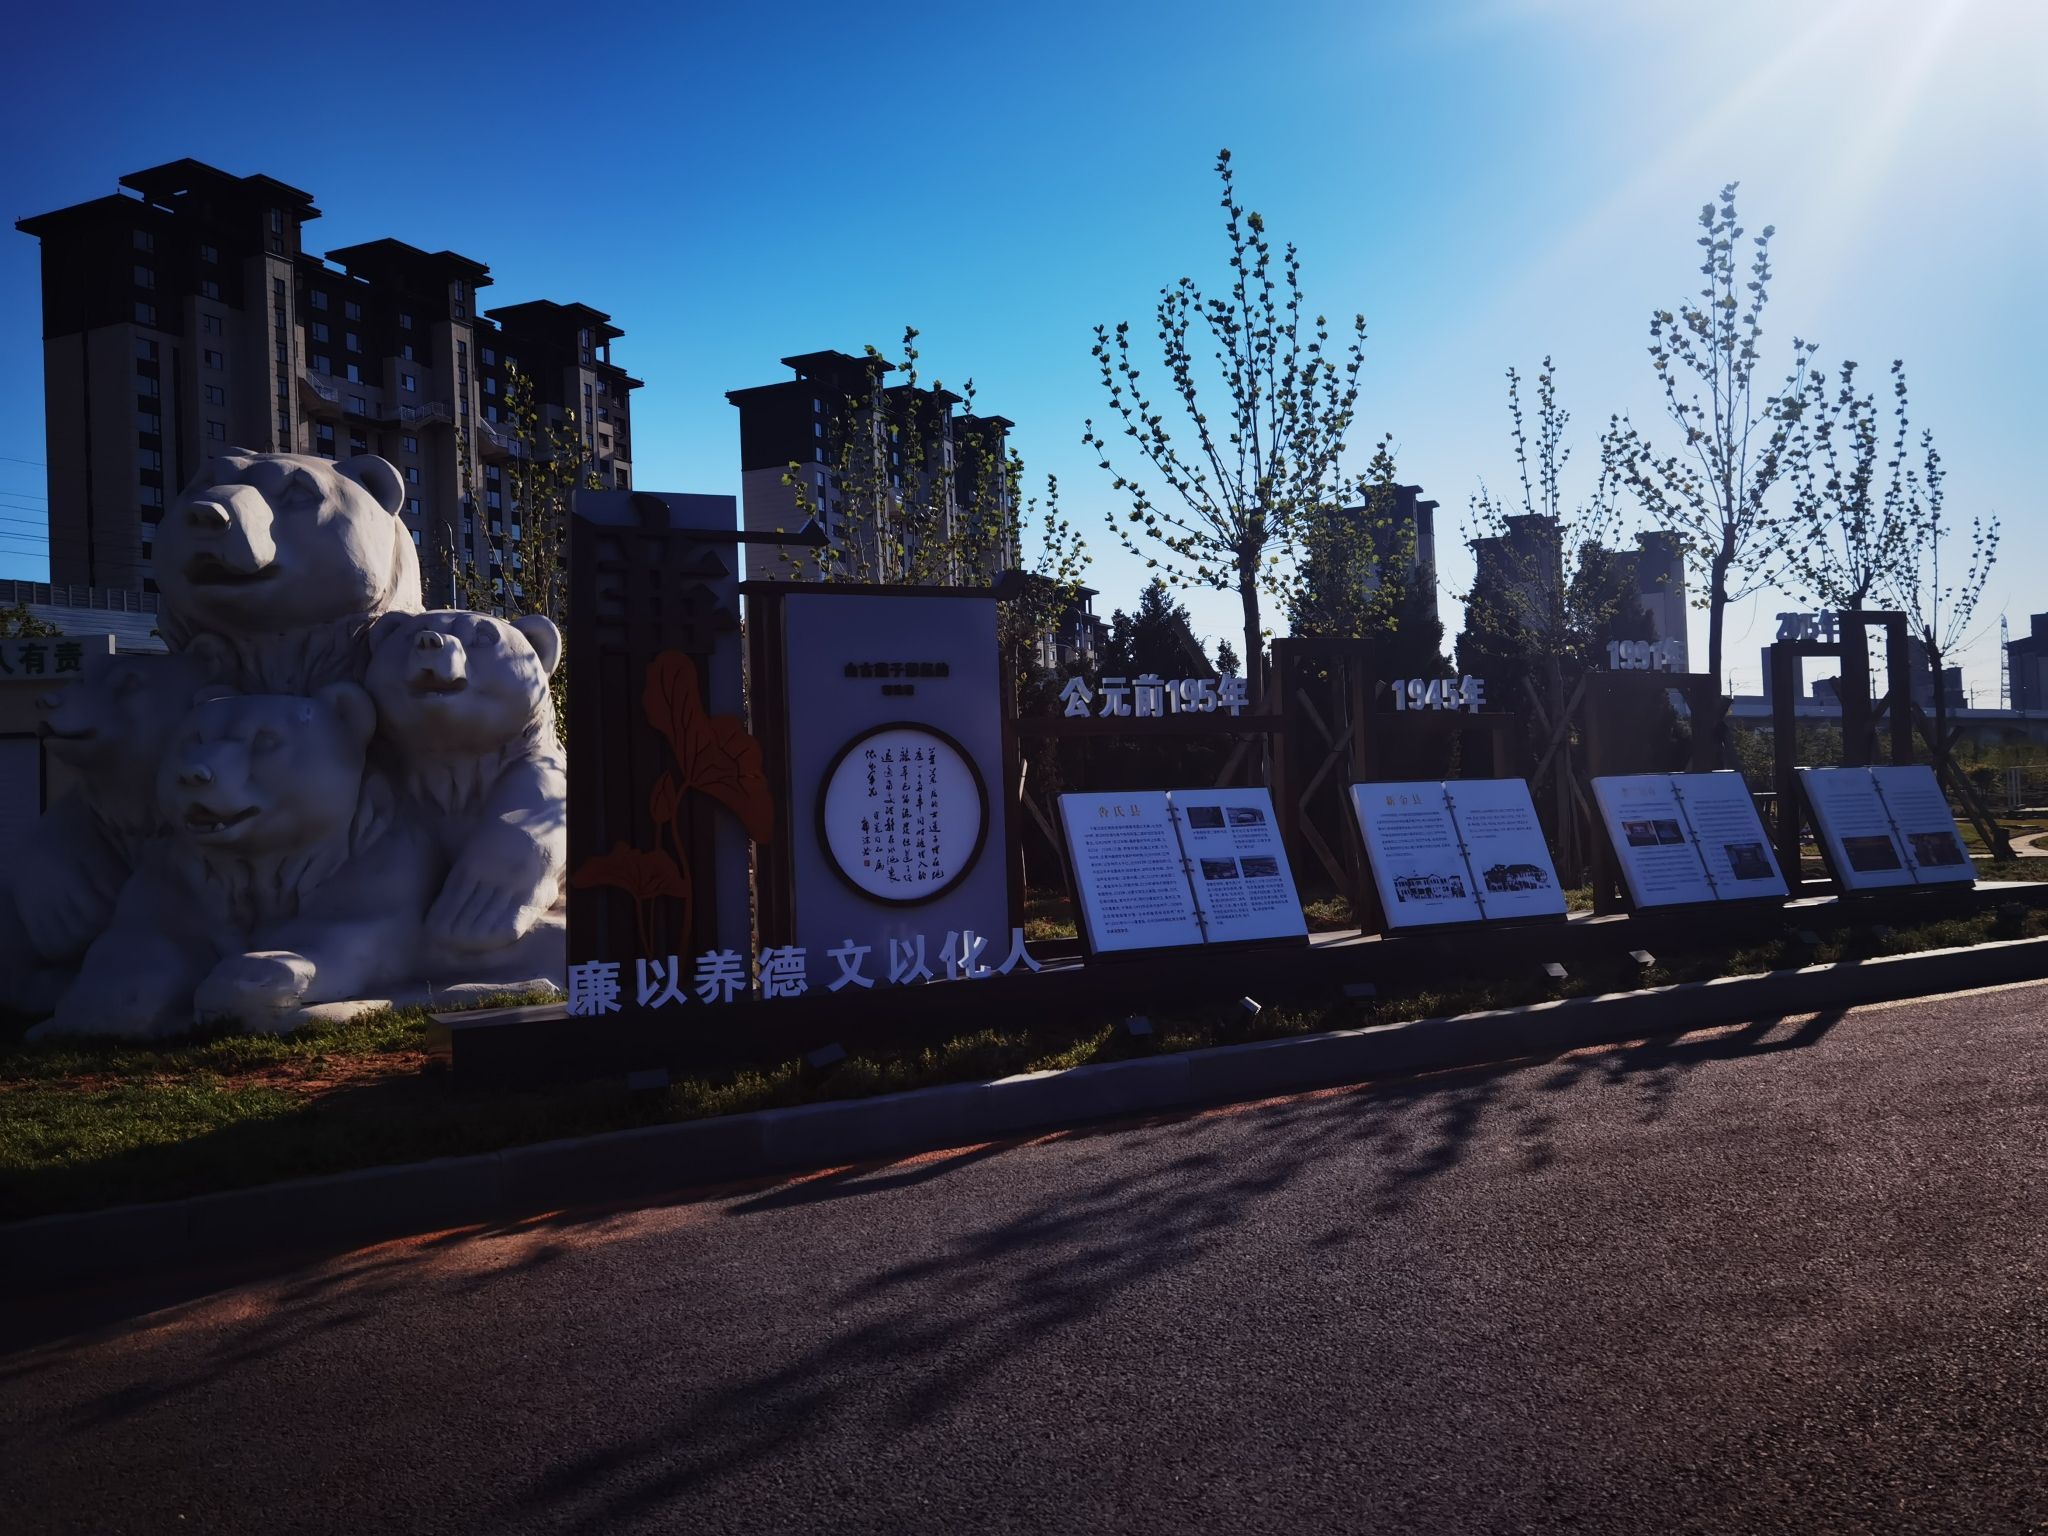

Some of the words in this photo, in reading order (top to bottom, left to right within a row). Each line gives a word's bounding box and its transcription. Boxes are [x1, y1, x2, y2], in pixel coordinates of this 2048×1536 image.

[1775, 608, 1840, 643] 2015年
[1605, 637, 1686, 673] 1991年
[1060, 673, 1249, 718] 公元前195年
[1391, 673, 1487, 714] 1945年
[567, 945, 809, 1017] 廉以养德
[826, 928, 1043, 992] 文以化人
